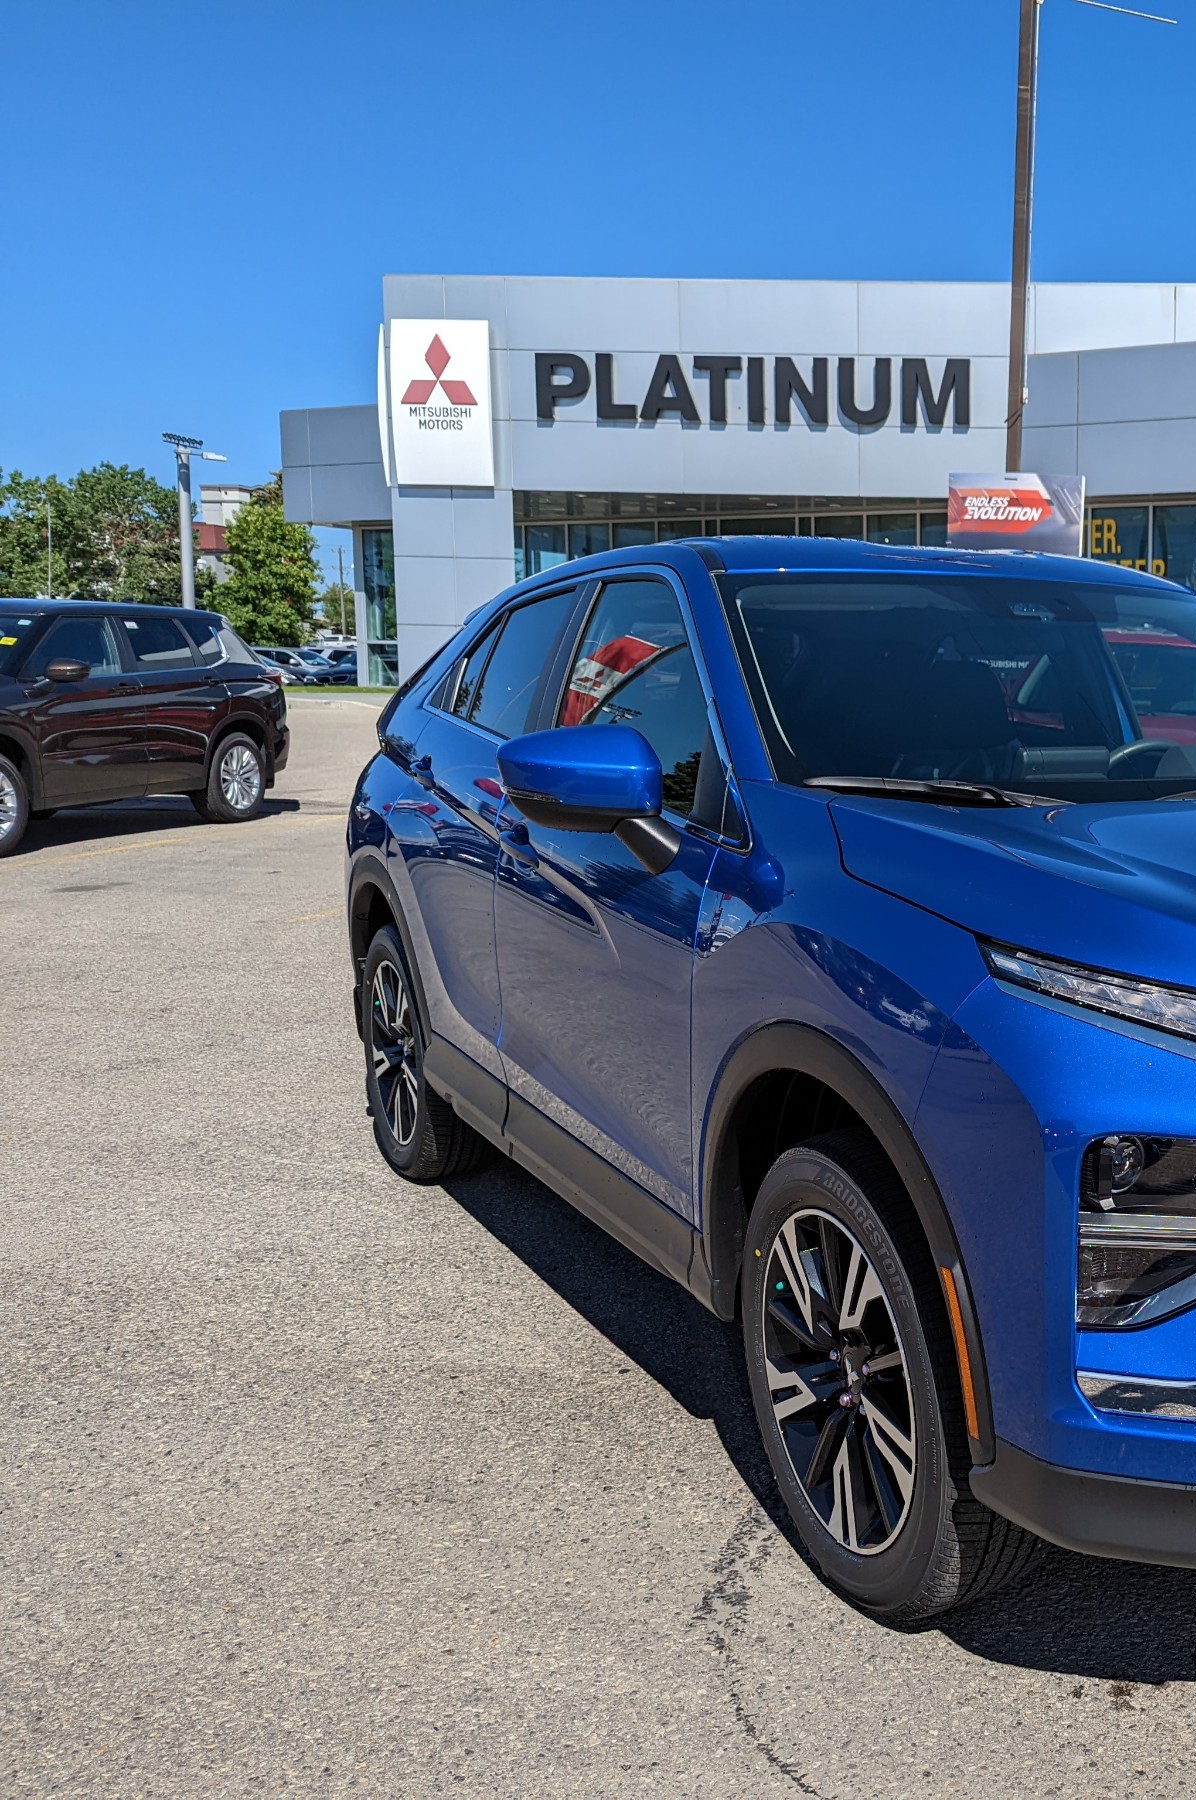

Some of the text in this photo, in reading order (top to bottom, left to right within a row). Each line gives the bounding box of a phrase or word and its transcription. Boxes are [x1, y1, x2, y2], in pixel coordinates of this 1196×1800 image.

[534, 352, 971, 426] PLATINUM
[409, 406, 472, 418] MITSUBISHI
[418, 419, 463, 431] MOTORS
[964, 496, 1011, 507] ENDLESS
[964, 506, 1043, 521] EVOLUTION
[822, 1172, 910, 1309] BRIDGESTONE
